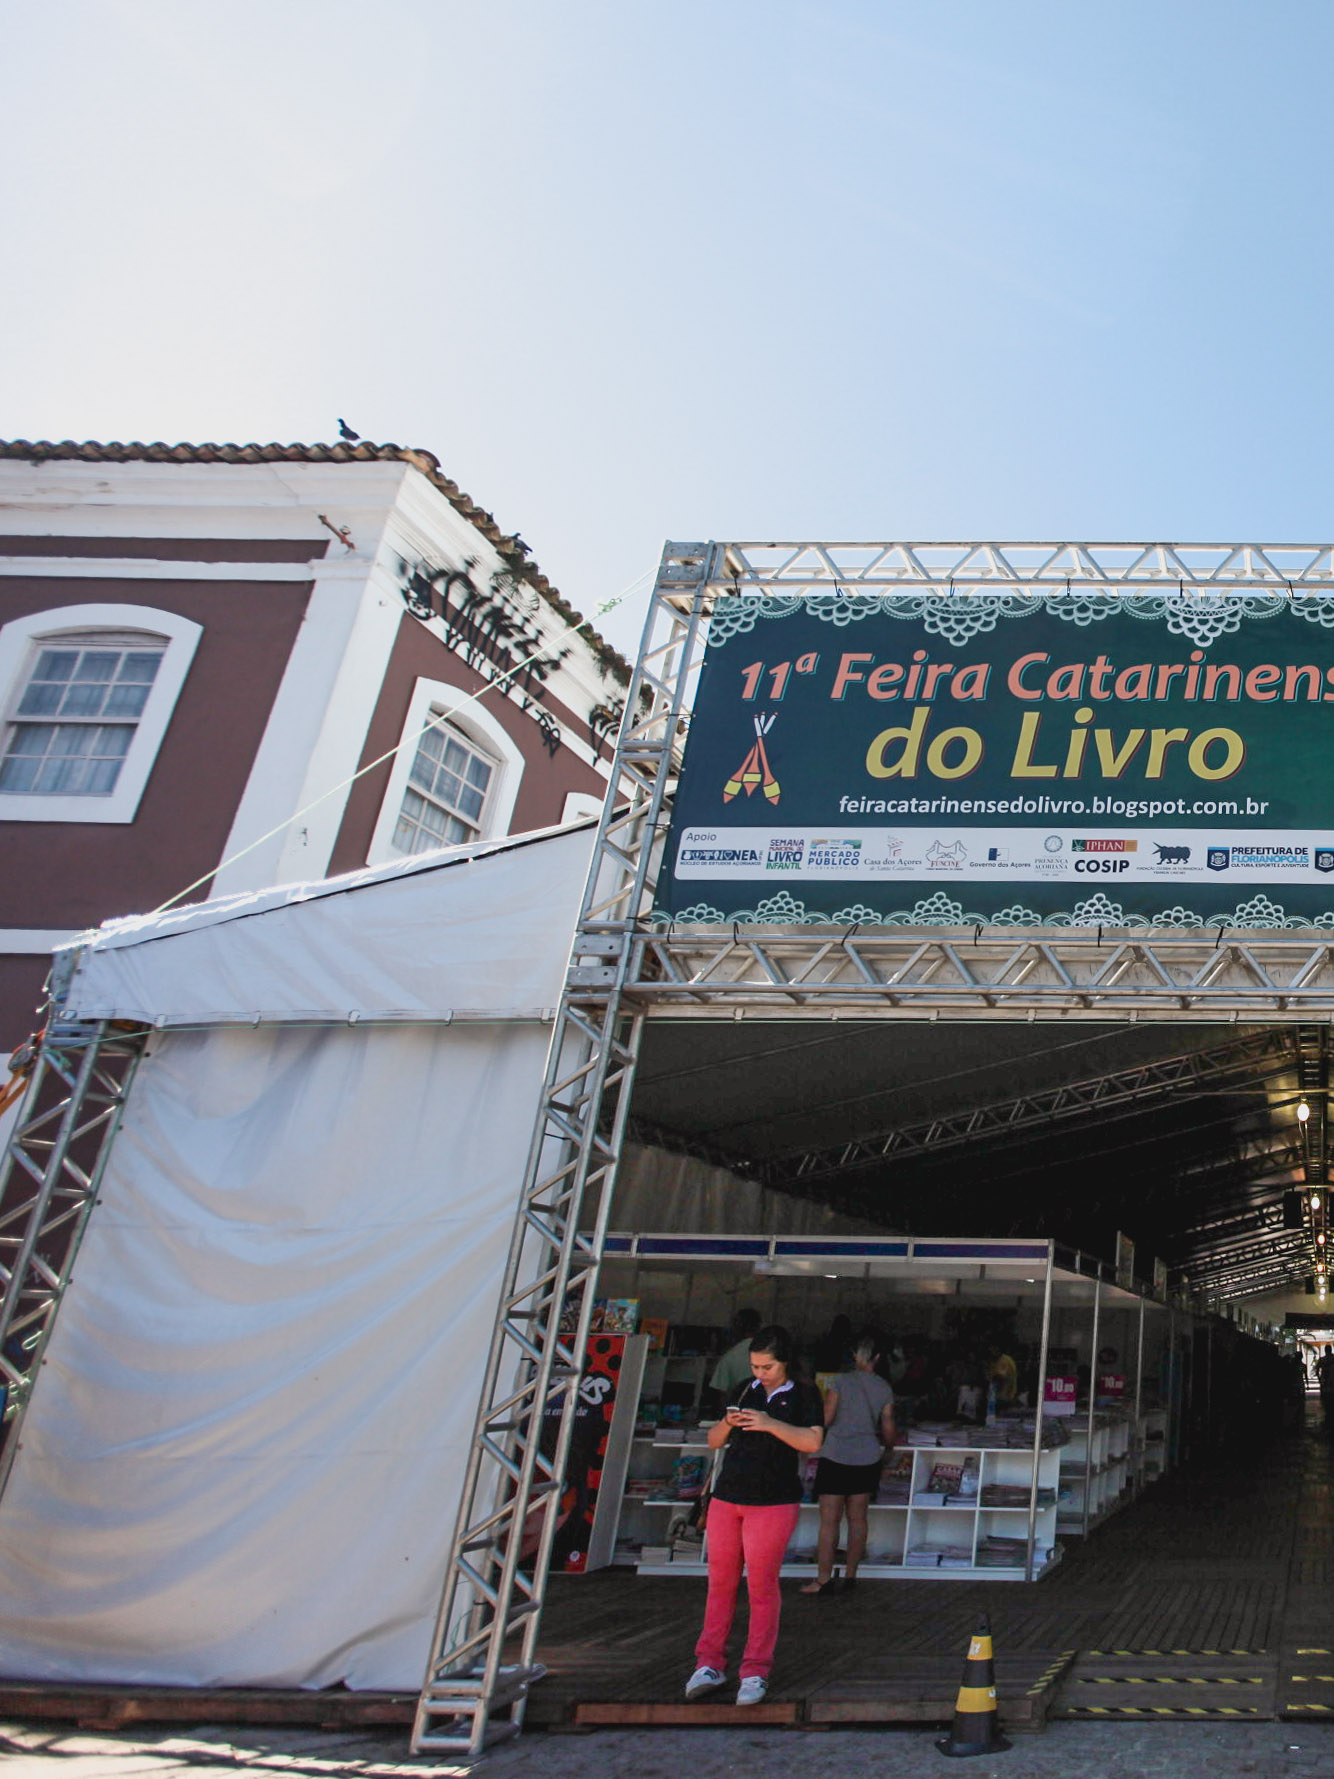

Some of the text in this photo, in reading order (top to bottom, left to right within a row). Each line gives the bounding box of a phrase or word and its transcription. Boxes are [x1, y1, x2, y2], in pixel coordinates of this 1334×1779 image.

[830, 649, 991, 702] Feira
[865, 706, 1247, 782] do Livro
[838, 795, 1269, 818] feiracatarinensedolivro.blogspot.com.br
[686, 832, 718, 843] Apoio
[770, 839, 805, 847] SEMANA
[1086, 840, 1124, 851] IPHAN
[1231, 847, 1293, 855] PREFEITURA
[767, 851, 803, 862] LIVRO
[809, 850, 861, 858] MERCADO
[766, 862, 802, 870] INFANTIL
[1074, 859, 1130, 873] COSIP
